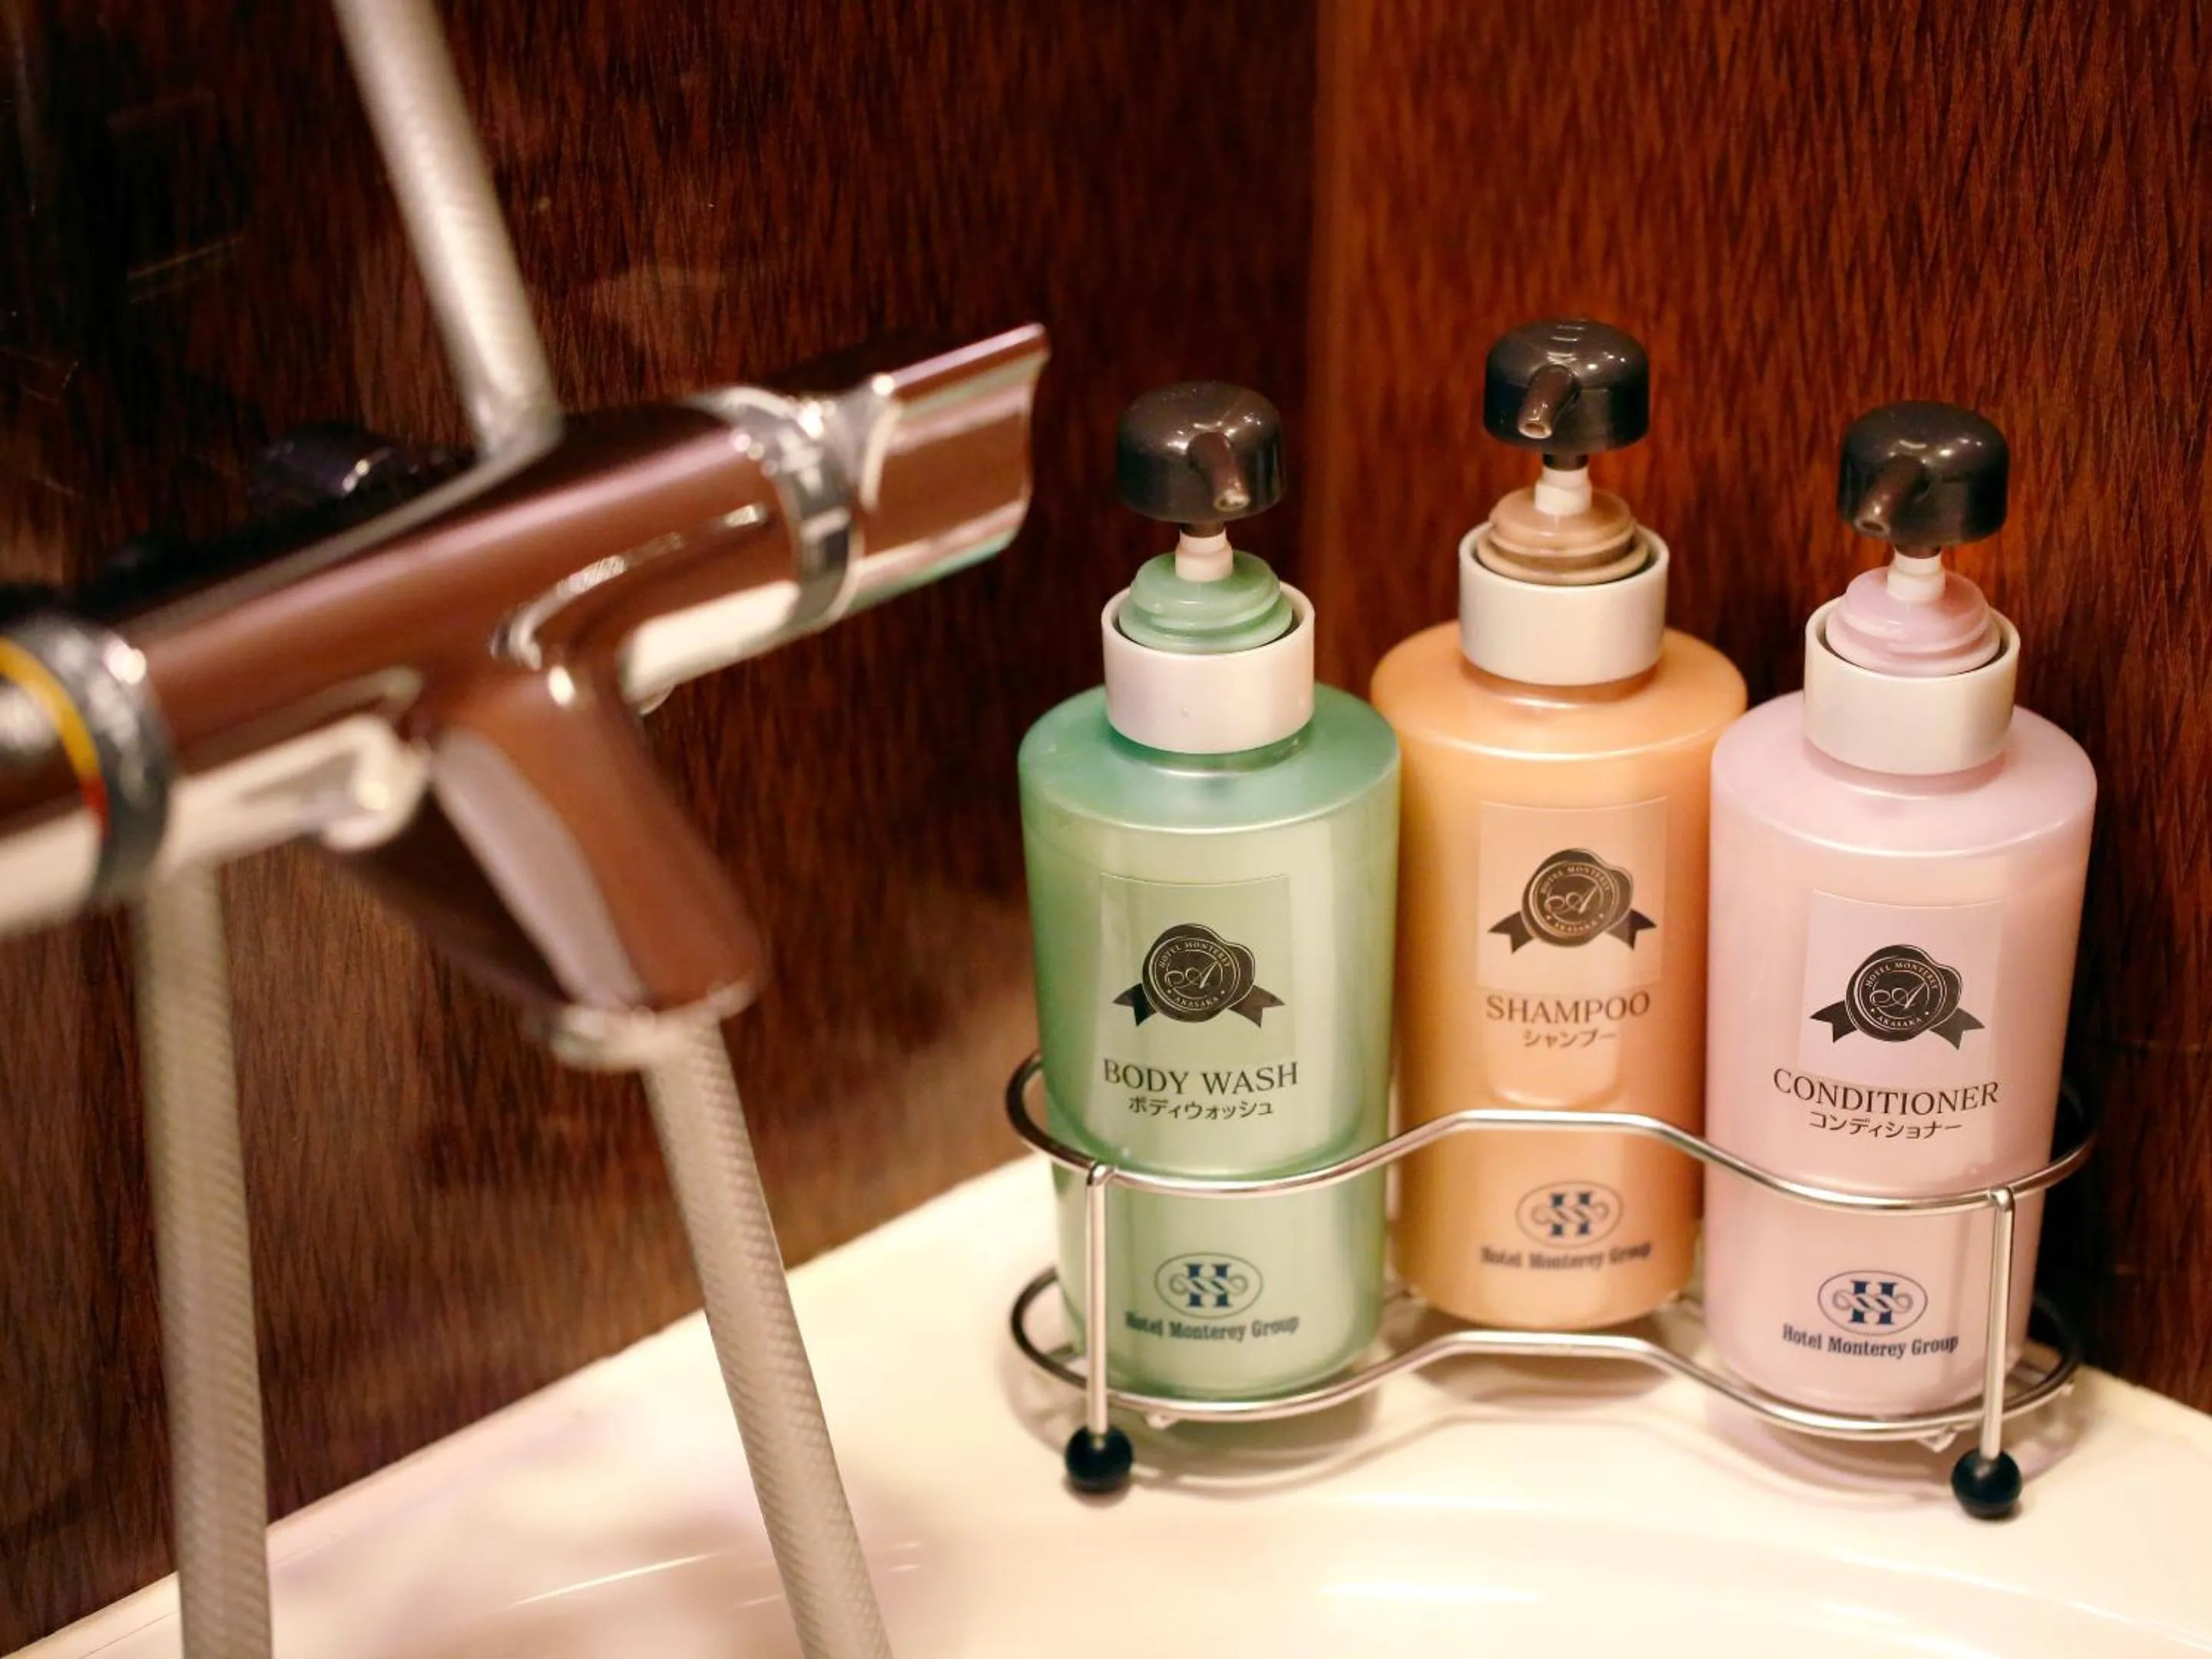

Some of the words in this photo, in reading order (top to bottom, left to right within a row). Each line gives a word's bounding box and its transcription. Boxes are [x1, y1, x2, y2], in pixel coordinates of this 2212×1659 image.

[1865, 965, 1891, 988] HOTEL
[1485, 991, 1651, 1025] SHAMPOO
[1104, 1058, 1189, 1095] BODY
[1200, 1061, 1298, 1095] WASH
[1773, 1068, 1999, 1115] CONDITIONER
[1128, 1096, 1273, 1121] ボディウォッシュ
[1810, 1111, 1962, 1139] コンディショナー
[1528, 1251, 1604, 1270] Monterey
[1124, 1310, 1163, 1337] Hotel
[1169, 1320, 1247, 1343] Monterey
[1251, 1316, 1300, 1338] Group
[1783, 1323, 1822, 1349] Hotel
[1827, 1335, 1906, 1359] Monterey
[1911, 1336, 1959, 1356] Group
